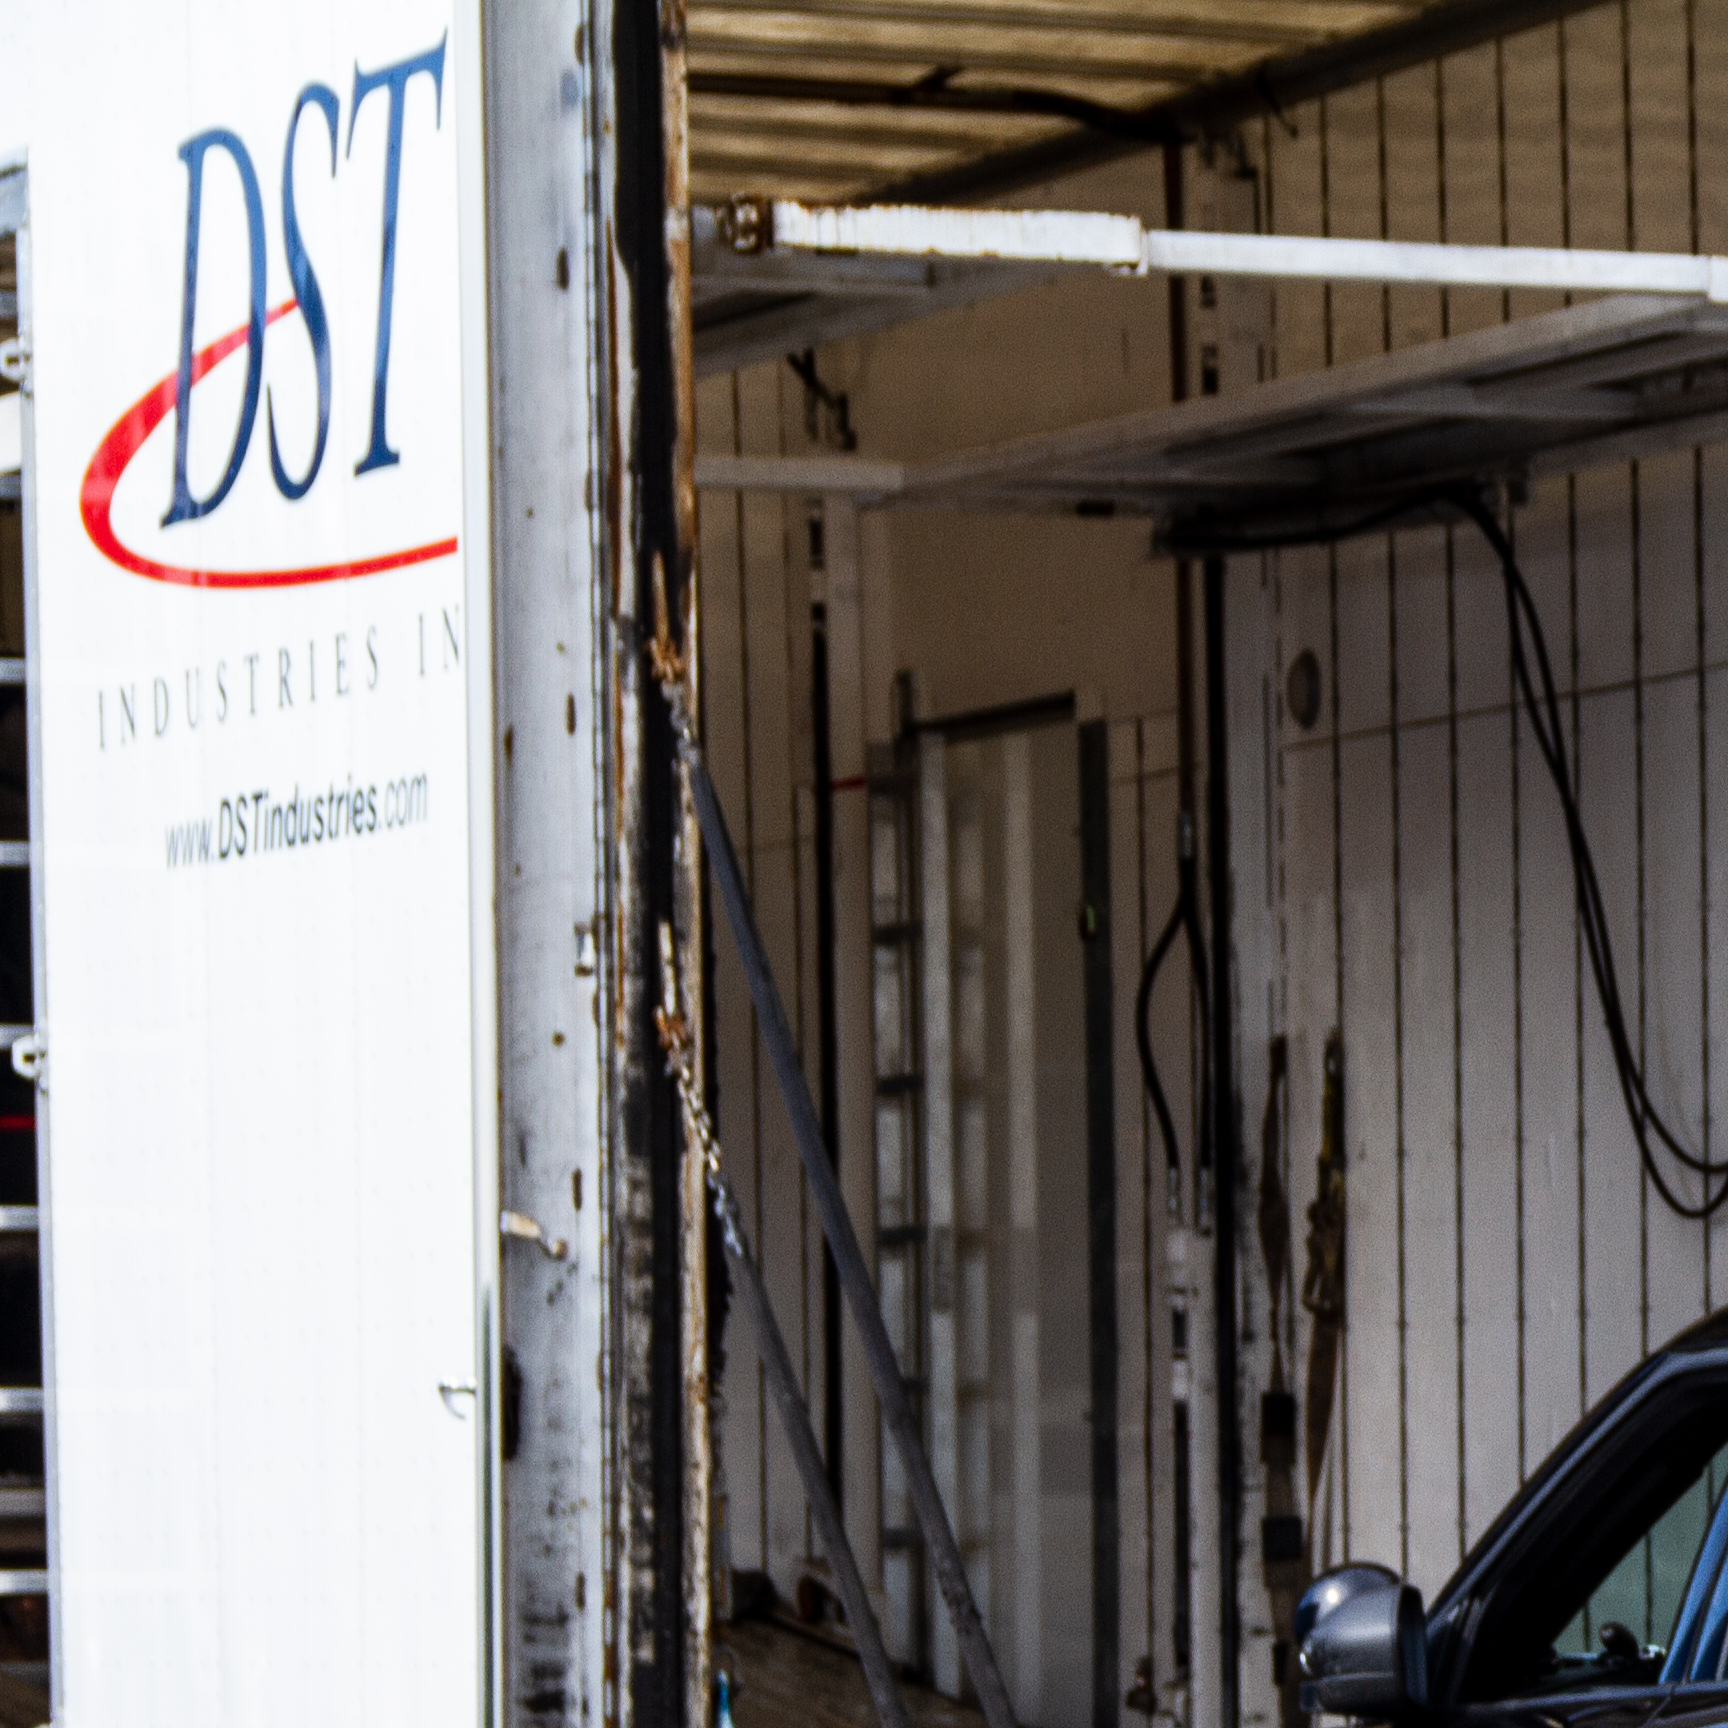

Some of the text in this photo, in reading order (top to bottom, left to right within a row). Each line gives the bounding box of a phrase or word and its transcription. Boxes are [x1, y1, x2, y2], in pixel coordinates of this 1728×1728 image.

[160, 26, 448, 530] DST
[97, 623, 380, 752] INDUSTRIES
[164, 771, 429, 871] www.DSTindustries.com
